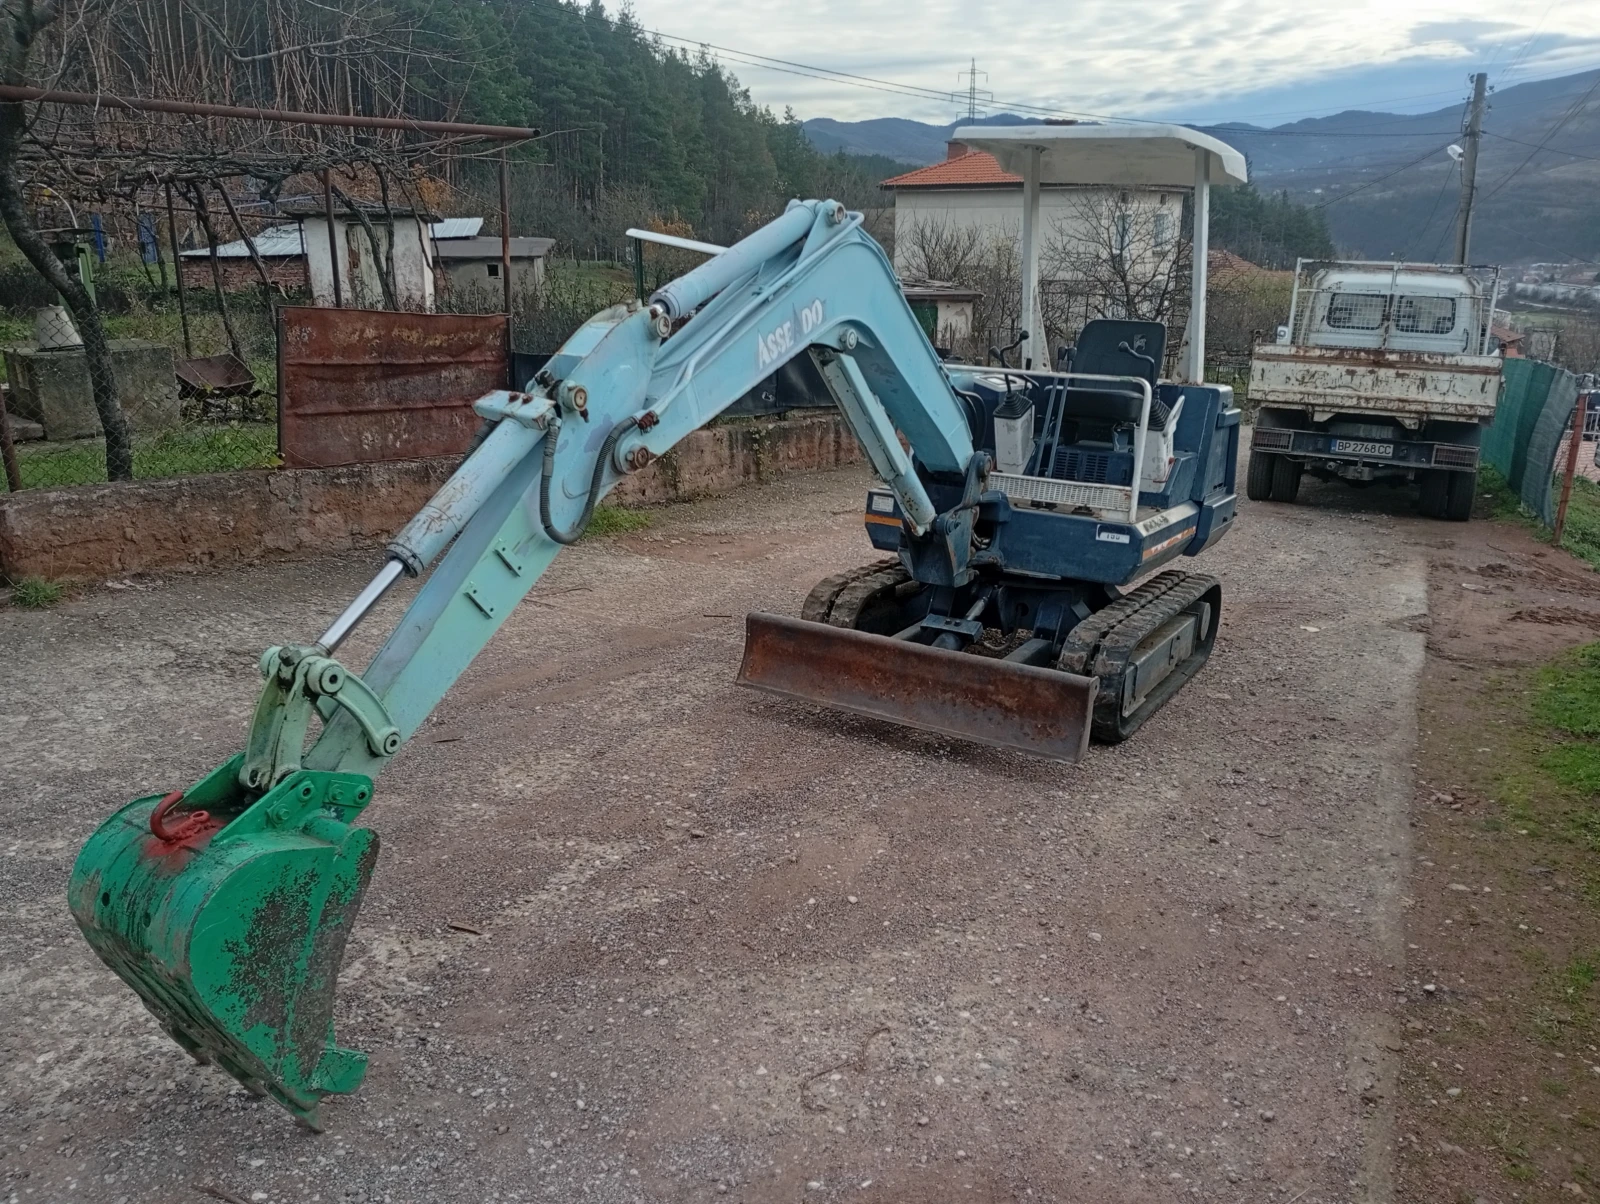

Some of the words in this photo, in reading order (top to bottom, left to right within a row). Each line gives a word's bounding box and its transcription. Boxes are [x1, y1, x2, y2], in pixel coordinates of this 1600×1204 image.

[1337, 441, 1350, 451] BP
[1352, 442, 1376, 453] 2768
[1378, 445, 1391, 455] CC
